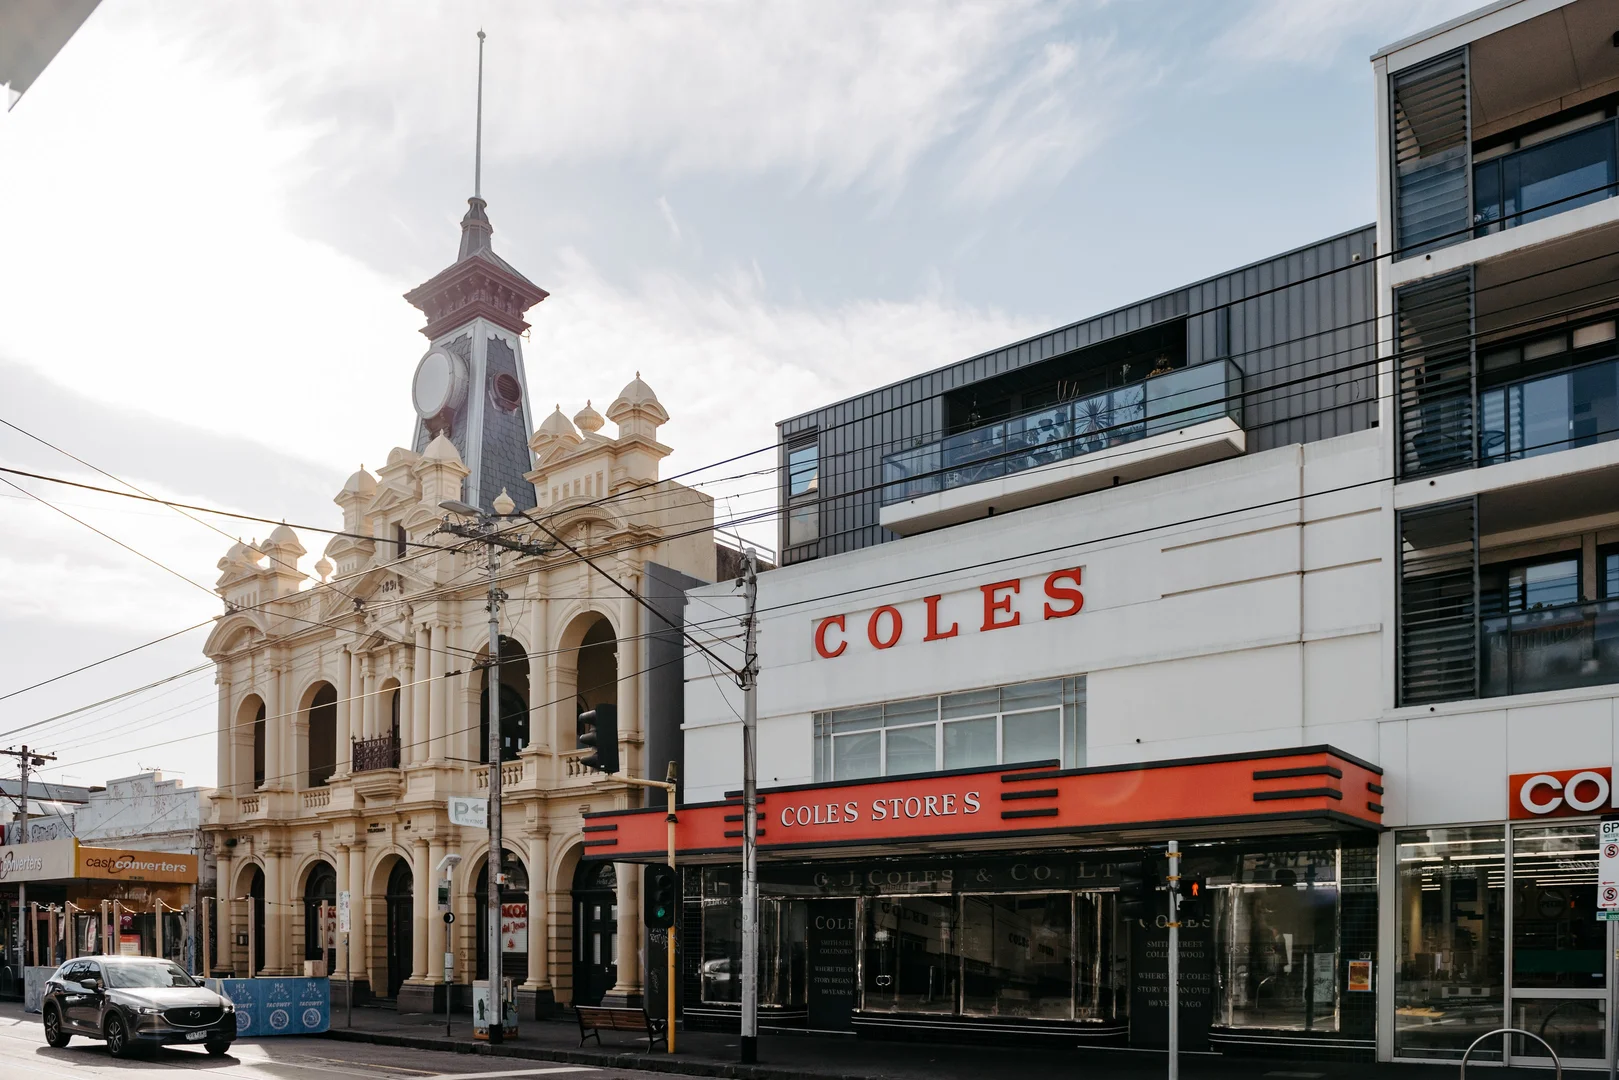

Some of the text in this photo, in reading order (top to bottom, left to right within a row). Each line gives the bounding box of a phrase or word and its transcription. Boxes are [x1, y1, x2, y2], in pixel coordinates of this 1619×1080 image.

[814, 567, 1084, 659] COLES
[1520, 766, 1619, 814] CO
[781, 791, 981, 827] COLES STORES
[868, 869, 953, 886] COLES
[976, 868, 993, 882] &
[1077, 861, 1118, 879] LT
[815, 916, 854, 930] COLE
[1138, 972, 1167, 980] WHERE
